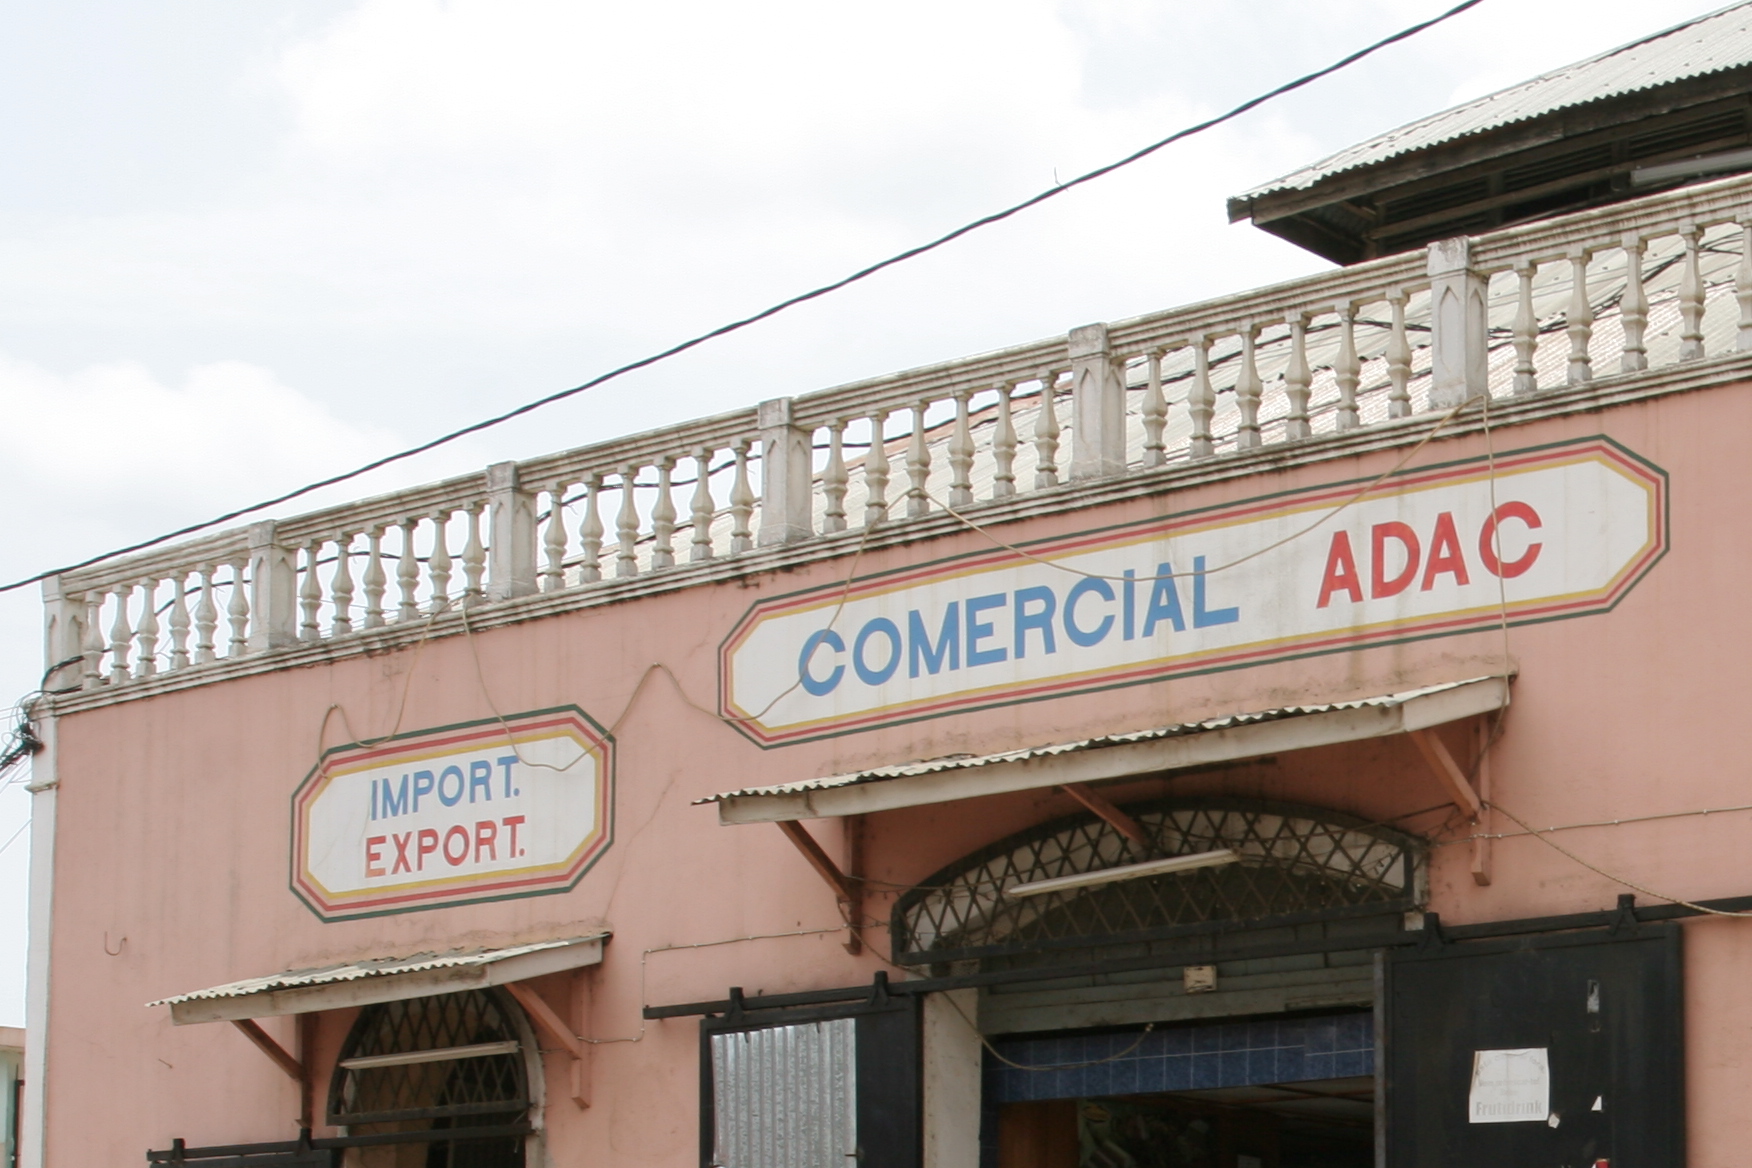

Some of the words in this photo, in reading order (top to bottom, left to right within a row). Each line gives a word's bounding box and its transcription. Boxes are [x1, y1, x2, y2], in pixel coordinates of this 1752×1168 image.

[798, 555, 1239, 697] COMERCIAL
[1317, 501, 1543, 609] ADAC
[371, 755, 520, 821] IMPORT.
[365, 815, 526, 878] EXPORT.
[1475, 1099, 1542, 1116] Frutidrink
